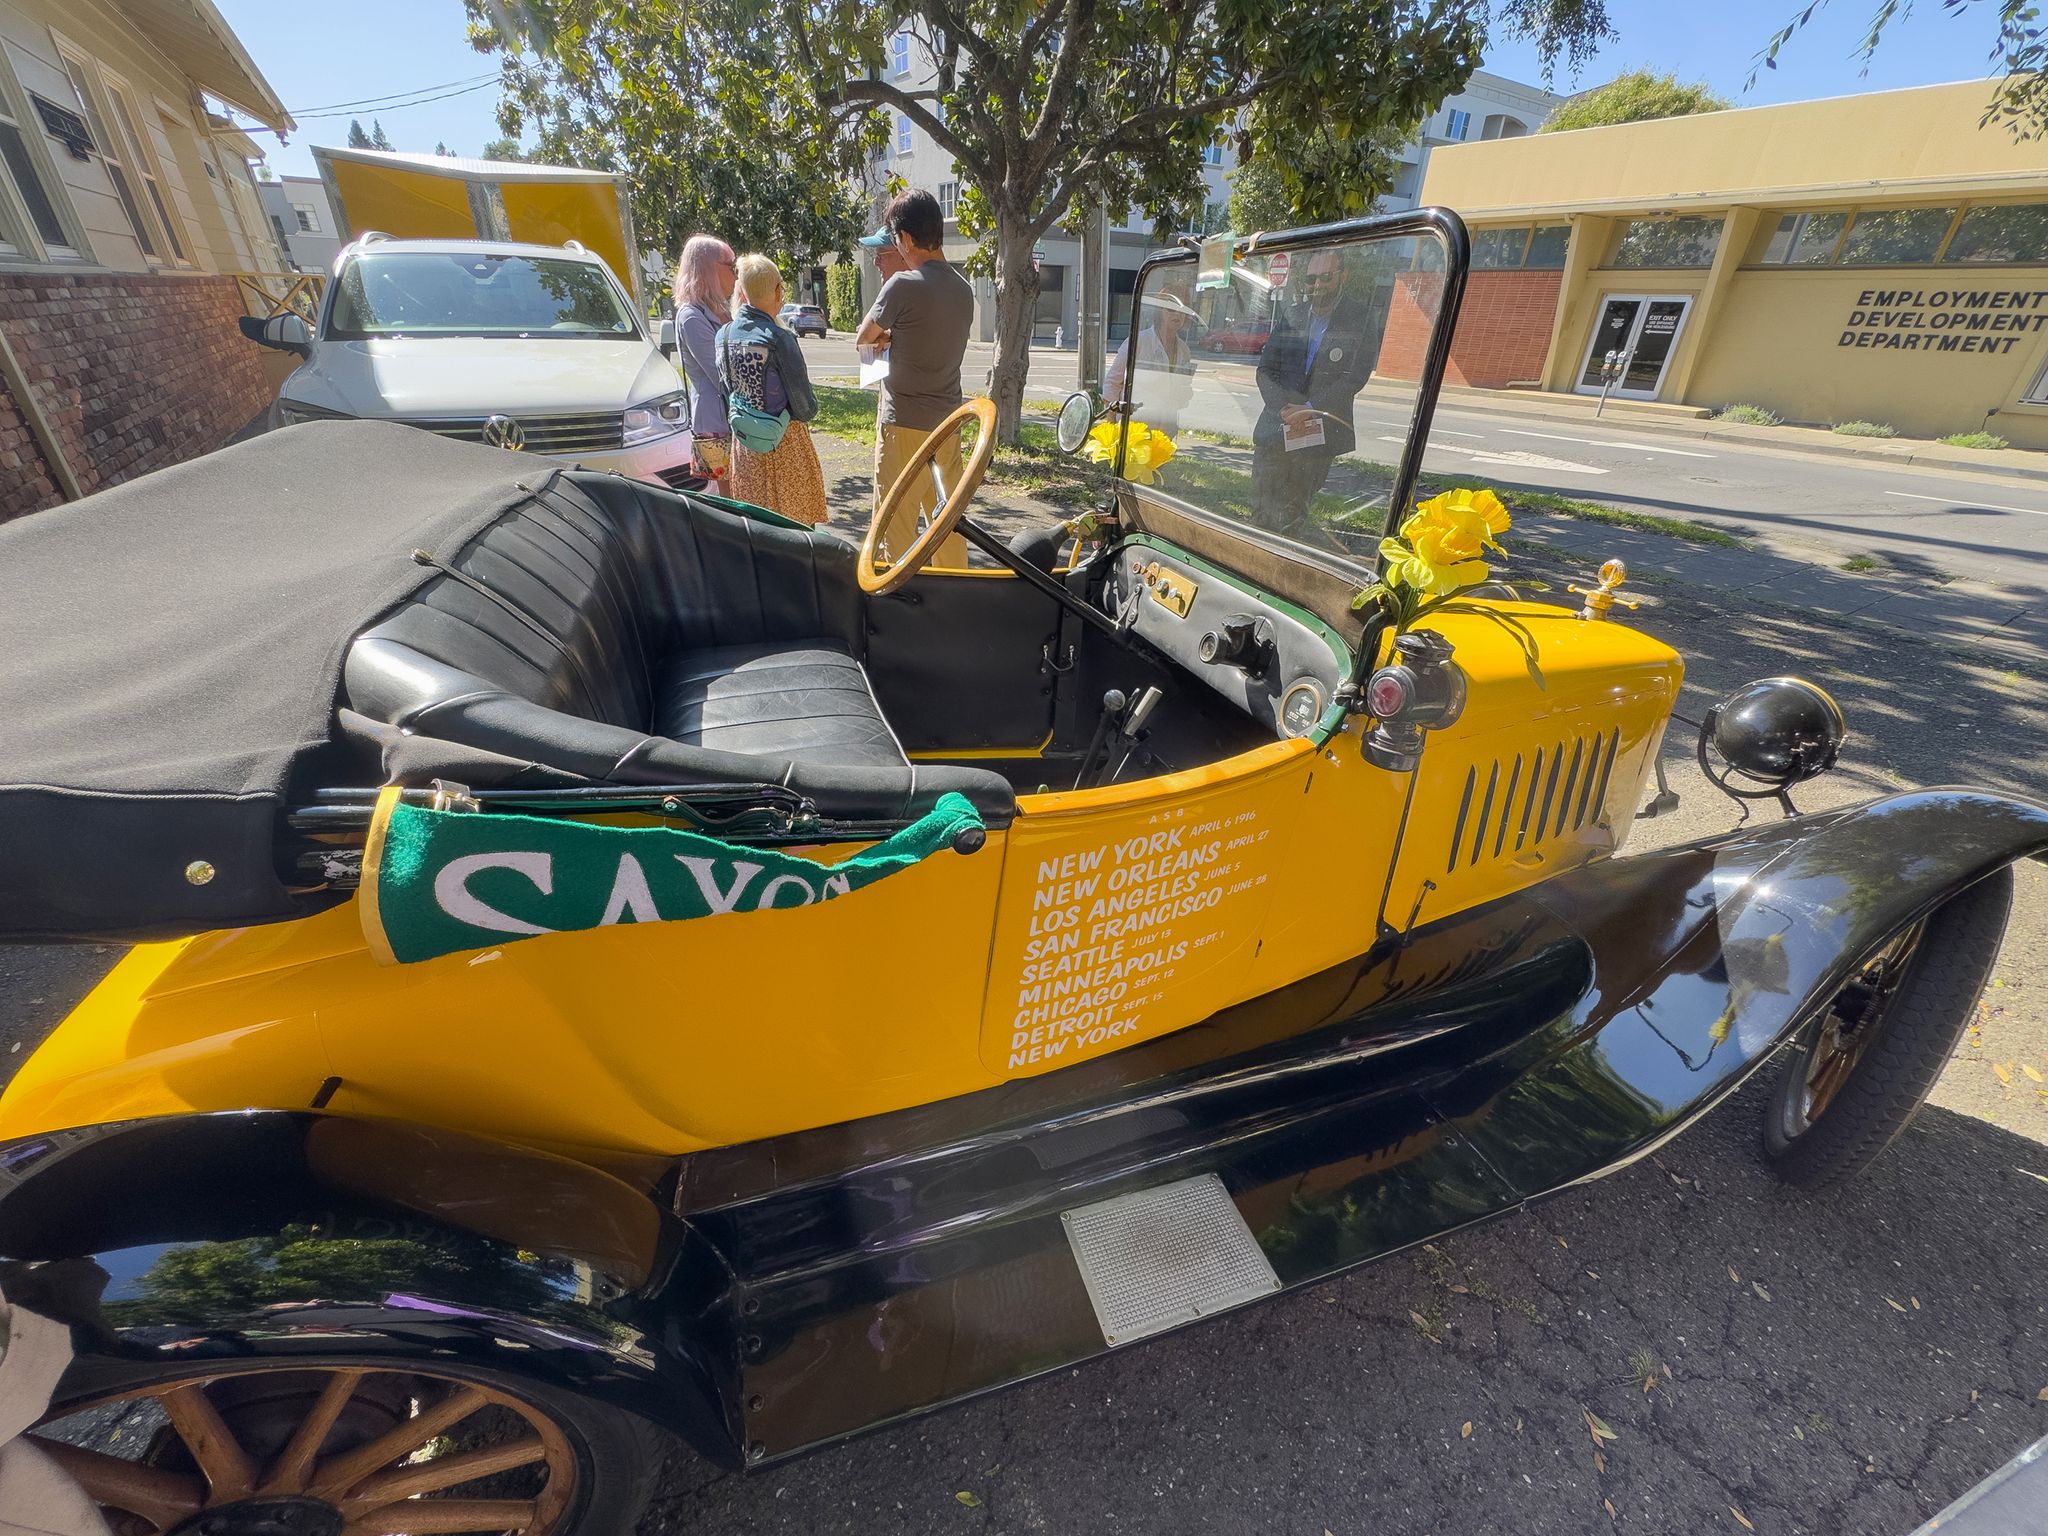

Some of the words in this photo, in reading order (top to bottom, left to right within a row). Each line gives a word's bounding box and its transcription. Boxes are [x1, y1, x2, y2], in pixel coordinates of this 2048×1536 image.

[1847, 310, 2048, 332] DEVELOPMENT
[1856, 290, 2048, 309] EMPLOYMENT
[1838, 331, 2021, 354] DEPARTMENT
[1033, 873, 1102, 911] NEW
[1107, 840, 1221, 892] ORLEANS
[1225, 835, 1256, 852] APRIL
[1258, 829, 1270, 841] 27
[1037, 845, 1108, 884] NEW
[1114, 825, 1186, 864] YORK
[1188, 820, 1222, 839] APRIL
[1224, 817, 1232, 828] 6
[1234, 810, 1256, 824] 1916
[1023, 929, 1080, 962] SAN
[1089, 887, 1223, 944] FRANCISCO
[1227, 880, 1253, 896] JUNE
[1255, 874, 1267, 885] 28
[1029, 903, 1081, 936] LOS
[1086, 871, 1200, 922] ANGELES
[1204, 864, 1232, 881] JUNE
[1234, 861, 1241, 871] 5
[1018, 940, 1189, 1008] MINNEAPOLIS
[1192, 932, 1219, 949] SEPT.
[1019, 940, 1126, 985] SEATTLE
[1131, 932, 1160, 949] JULY
[1011, 1003, 1119, 1050] DETROIT
[1121, 998, 1149, 1012] SEPT.
[1013, 982, 1128, 1029] CHICAGO
[1133, 973, 1162, 989] SEPT.
[1163, 968, 1175, 978] 12
[1007, 1037, 1070, 1070] NEW
[1075, 1014, 1141, 1051] YORK
